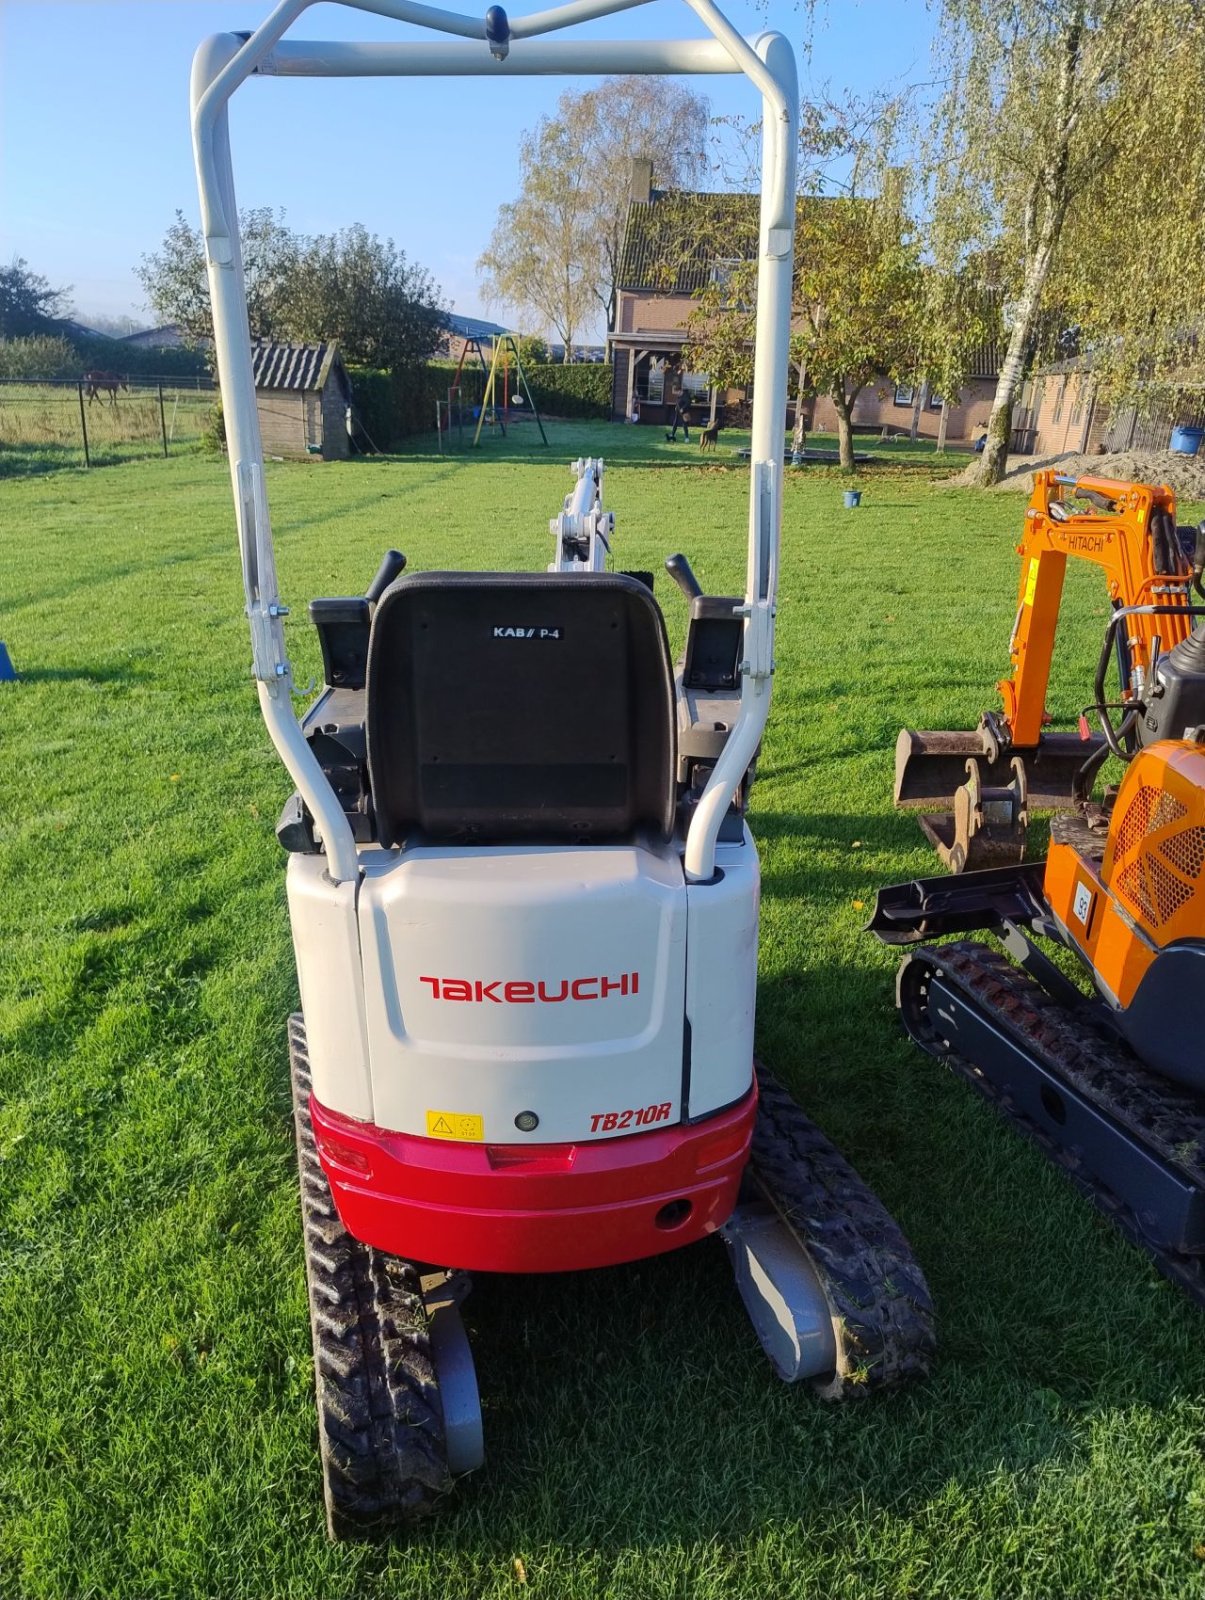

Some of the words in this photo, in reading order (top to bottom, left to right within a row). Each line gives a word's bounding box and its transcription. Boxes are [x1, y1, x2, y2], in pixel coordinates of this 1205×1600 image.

[1069, 535, 1104, 553] HITACHI
[540, 628, 560, 639] P-4
[1078, 896, 1088, 920] 93
[590, 1102, 672, 1133] TB210R
